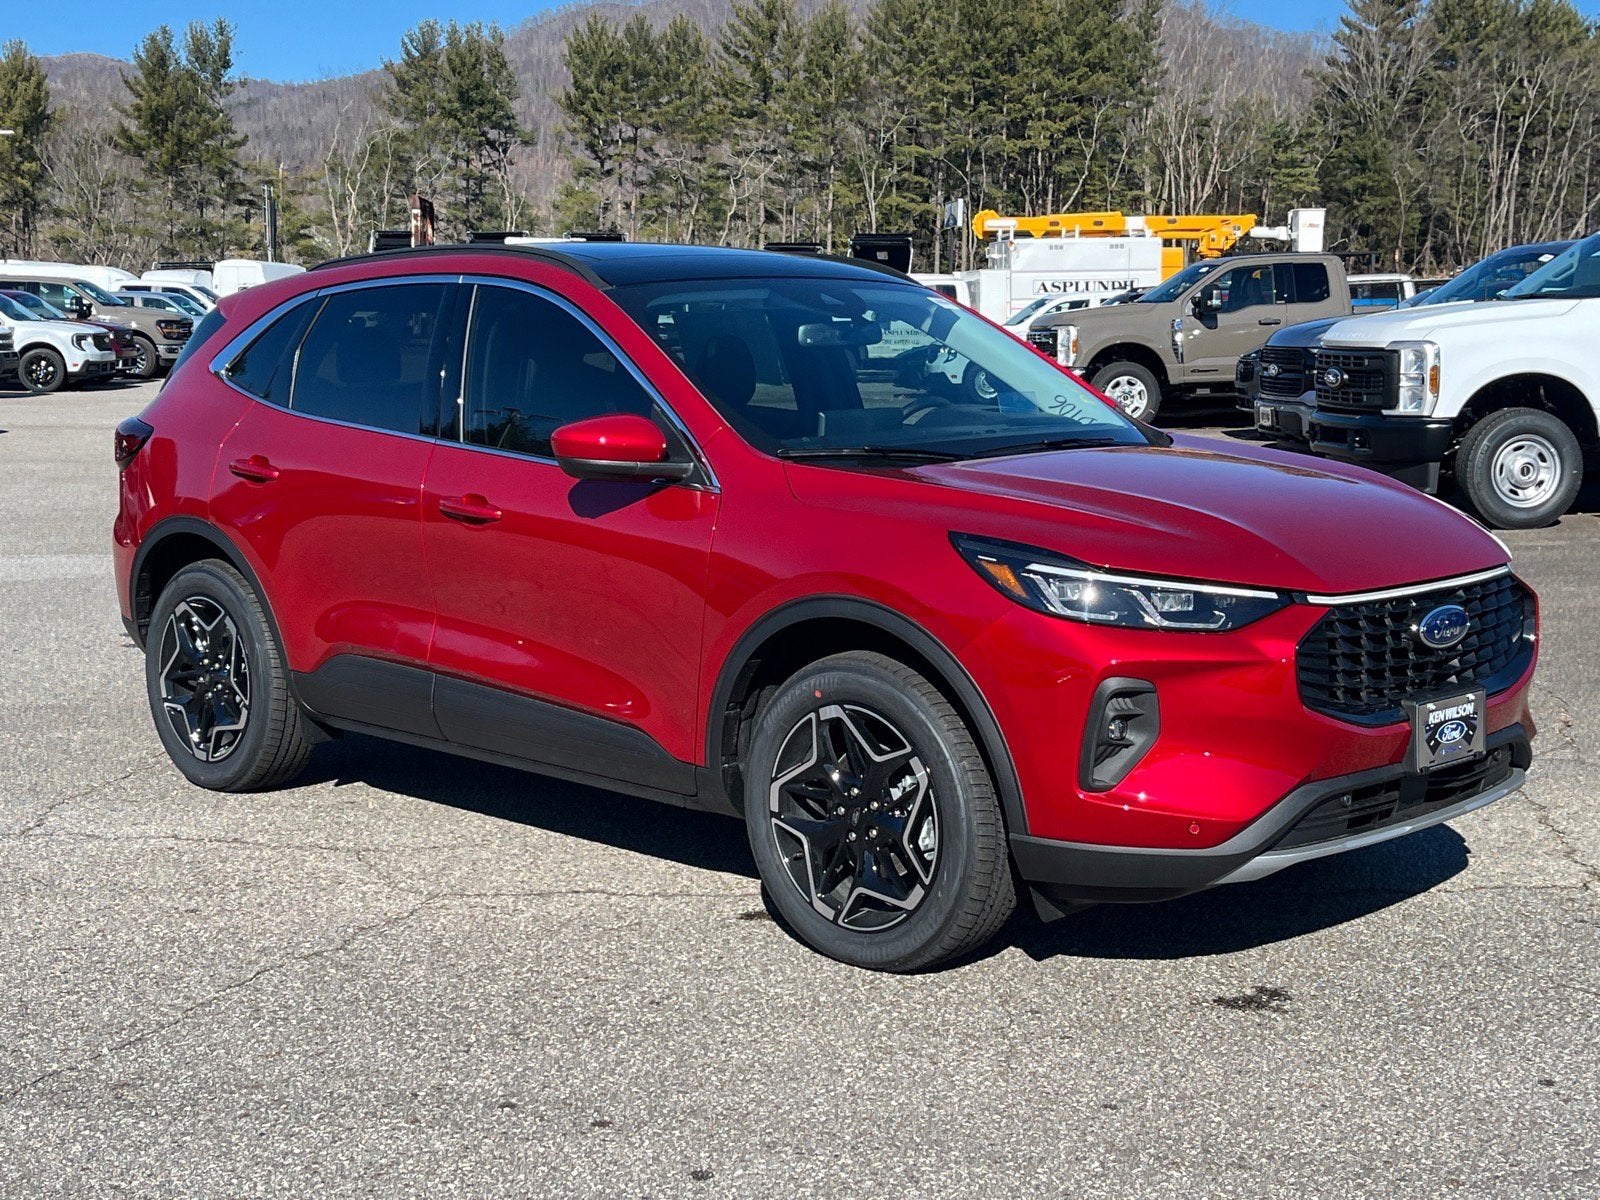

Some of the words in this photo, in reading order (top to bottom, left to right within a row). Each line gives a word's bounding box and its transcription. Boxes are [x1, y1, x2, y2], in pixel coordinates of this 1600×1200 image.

[1037, 280, 1136, 293] ASPLUNDH
[1428, 710, 1446, 724] KEN
[1446, 702, 1475, 720] WILSON
[1442, 724, 1462, 741] Ford
